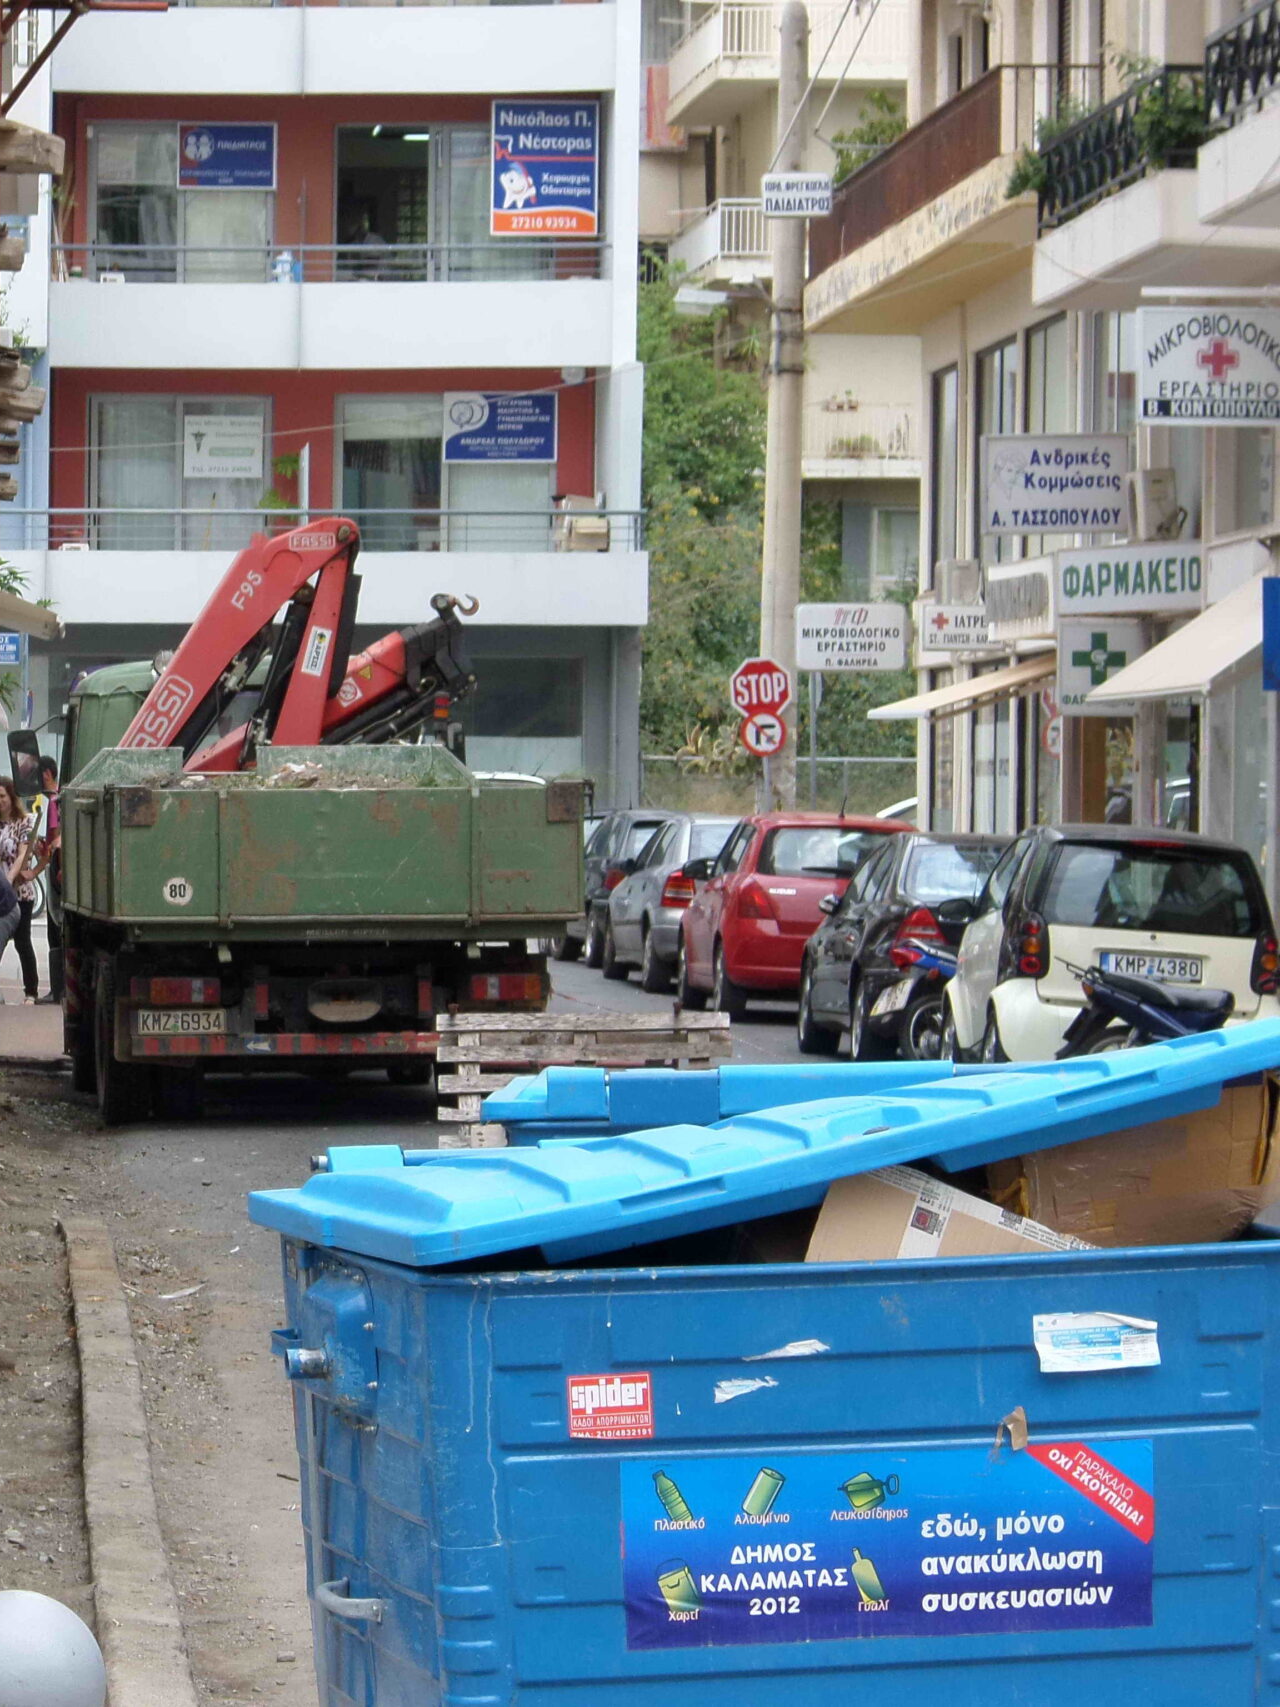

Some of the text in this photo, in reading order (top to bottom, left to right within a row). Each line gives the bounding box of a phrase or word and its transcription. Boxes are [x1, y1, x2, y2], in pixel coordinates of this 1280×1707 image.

[500, 109, 592, 127] Νικόλαος Π.
[519, 133, 592, 154] Νέστορας
[765, 197, 830, 211] ΠΑΙΔΙΑΤΡΟΣ
[512, 216, 543, 229] 27210
[1159, 380, 1279, 400] ΕΡΓΑΣΤΗΡΙΟ
[1147, 400, 1280, 417] Β. ΚΟΝΤΟΠΟΥΛΟ
[1030, 446, 1111, 469] Ανδρικές
[1024, 471, 1121, 493] Κομμώσεις
[991, 508, 1121, 527] Α. ΤΑΣΣΟΠΟΥΛΟΥ
[1062, 556, 1202, 598] ΦΑΡΜΑΚΕΙΟ
[231, 569, 263, 611] F95
[802, 627, 900, 638] ΜΙΚΡΟΒΙΟΛΟΓΙΚΟ
[817, 641, 886, 652] ΕΡΓΑΣΤΗΡΙΟ
[837, 658, 878, 667] ΦΑΛΗΡΕΑ
[735, 672, 787, 706] STOP
[131, 683, 187, 747] ASSI
[169, 884, 186, 898] 80
[1114, 956, 1199, 977] KMP 4380
[141, 1012, 222, 1031] KMZ 6934
[571, 1377, 648, 1414] spider
[573, 1413, 649, 1428] ΚΑΔΟΙ ΑΠΟΡΡΙΜΜΑΤΩΝ
[1074, 1450, 1134, 1501] ΠΑΡΑΚΑΛΩ
[1048, 1449, 1144, 1526] ΟΧΙ ΣΚΟΥΠΙΔΙΑ!
[654, 1518, 705, 1531] Πλαστικό
[734, 1512, 790, 1527] Αλουμίνιο
[830, 1508, 908, 1522] Λευκοσίδηρος
[921, 1510, 1065, 1542] εδώ, μόνο
[730, 1542, 817, 1565] ΔΗΜΟΣ
[921, 1546, 1103, 1576] ανακύκλωση
[700, 1568, 849, 1593] ΚΑΛΑΜΑΤΑΣ
[749, 1596, 801, 1616] 2012
[921, 1581, 1114, 1613] συσκευασιών
[668, 1609, 701, 1624] Χαρτί
